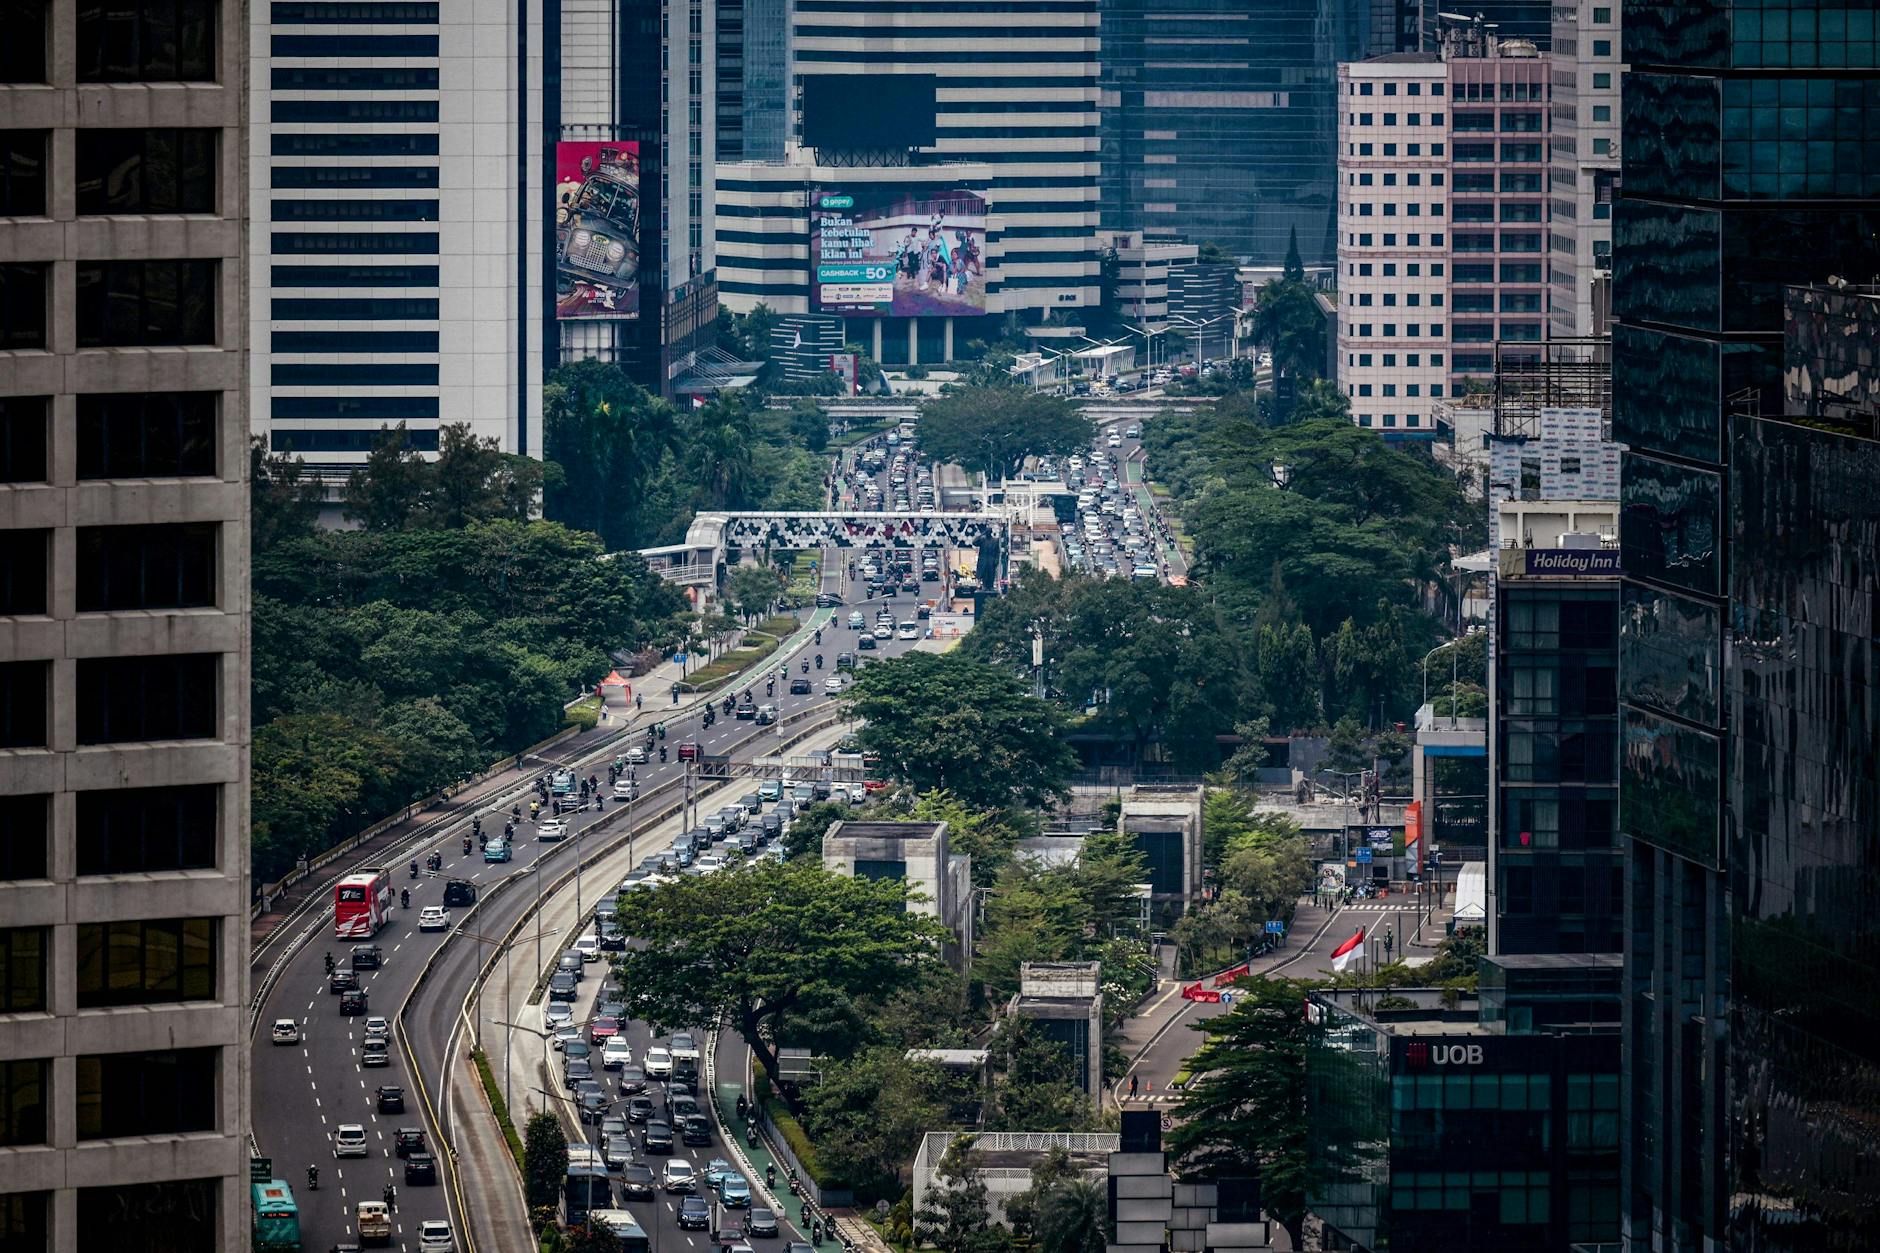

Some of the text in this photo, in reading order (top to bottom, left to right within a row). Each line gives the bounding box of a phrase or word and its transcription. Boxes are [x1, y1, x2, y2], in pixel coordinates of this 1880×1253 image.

[820, 217, 853, 226] Bukan
[820, 228, 870, 238] kebetulan
[820, 238, 875, 248] kamu lihat
[820, 249, 863, 259] iklan ini
[1533, 553, 1589, 571] Holiday
[1590, 553, 1612, 568] Inn
[1432, 1045, 1484, 1065] UOB
